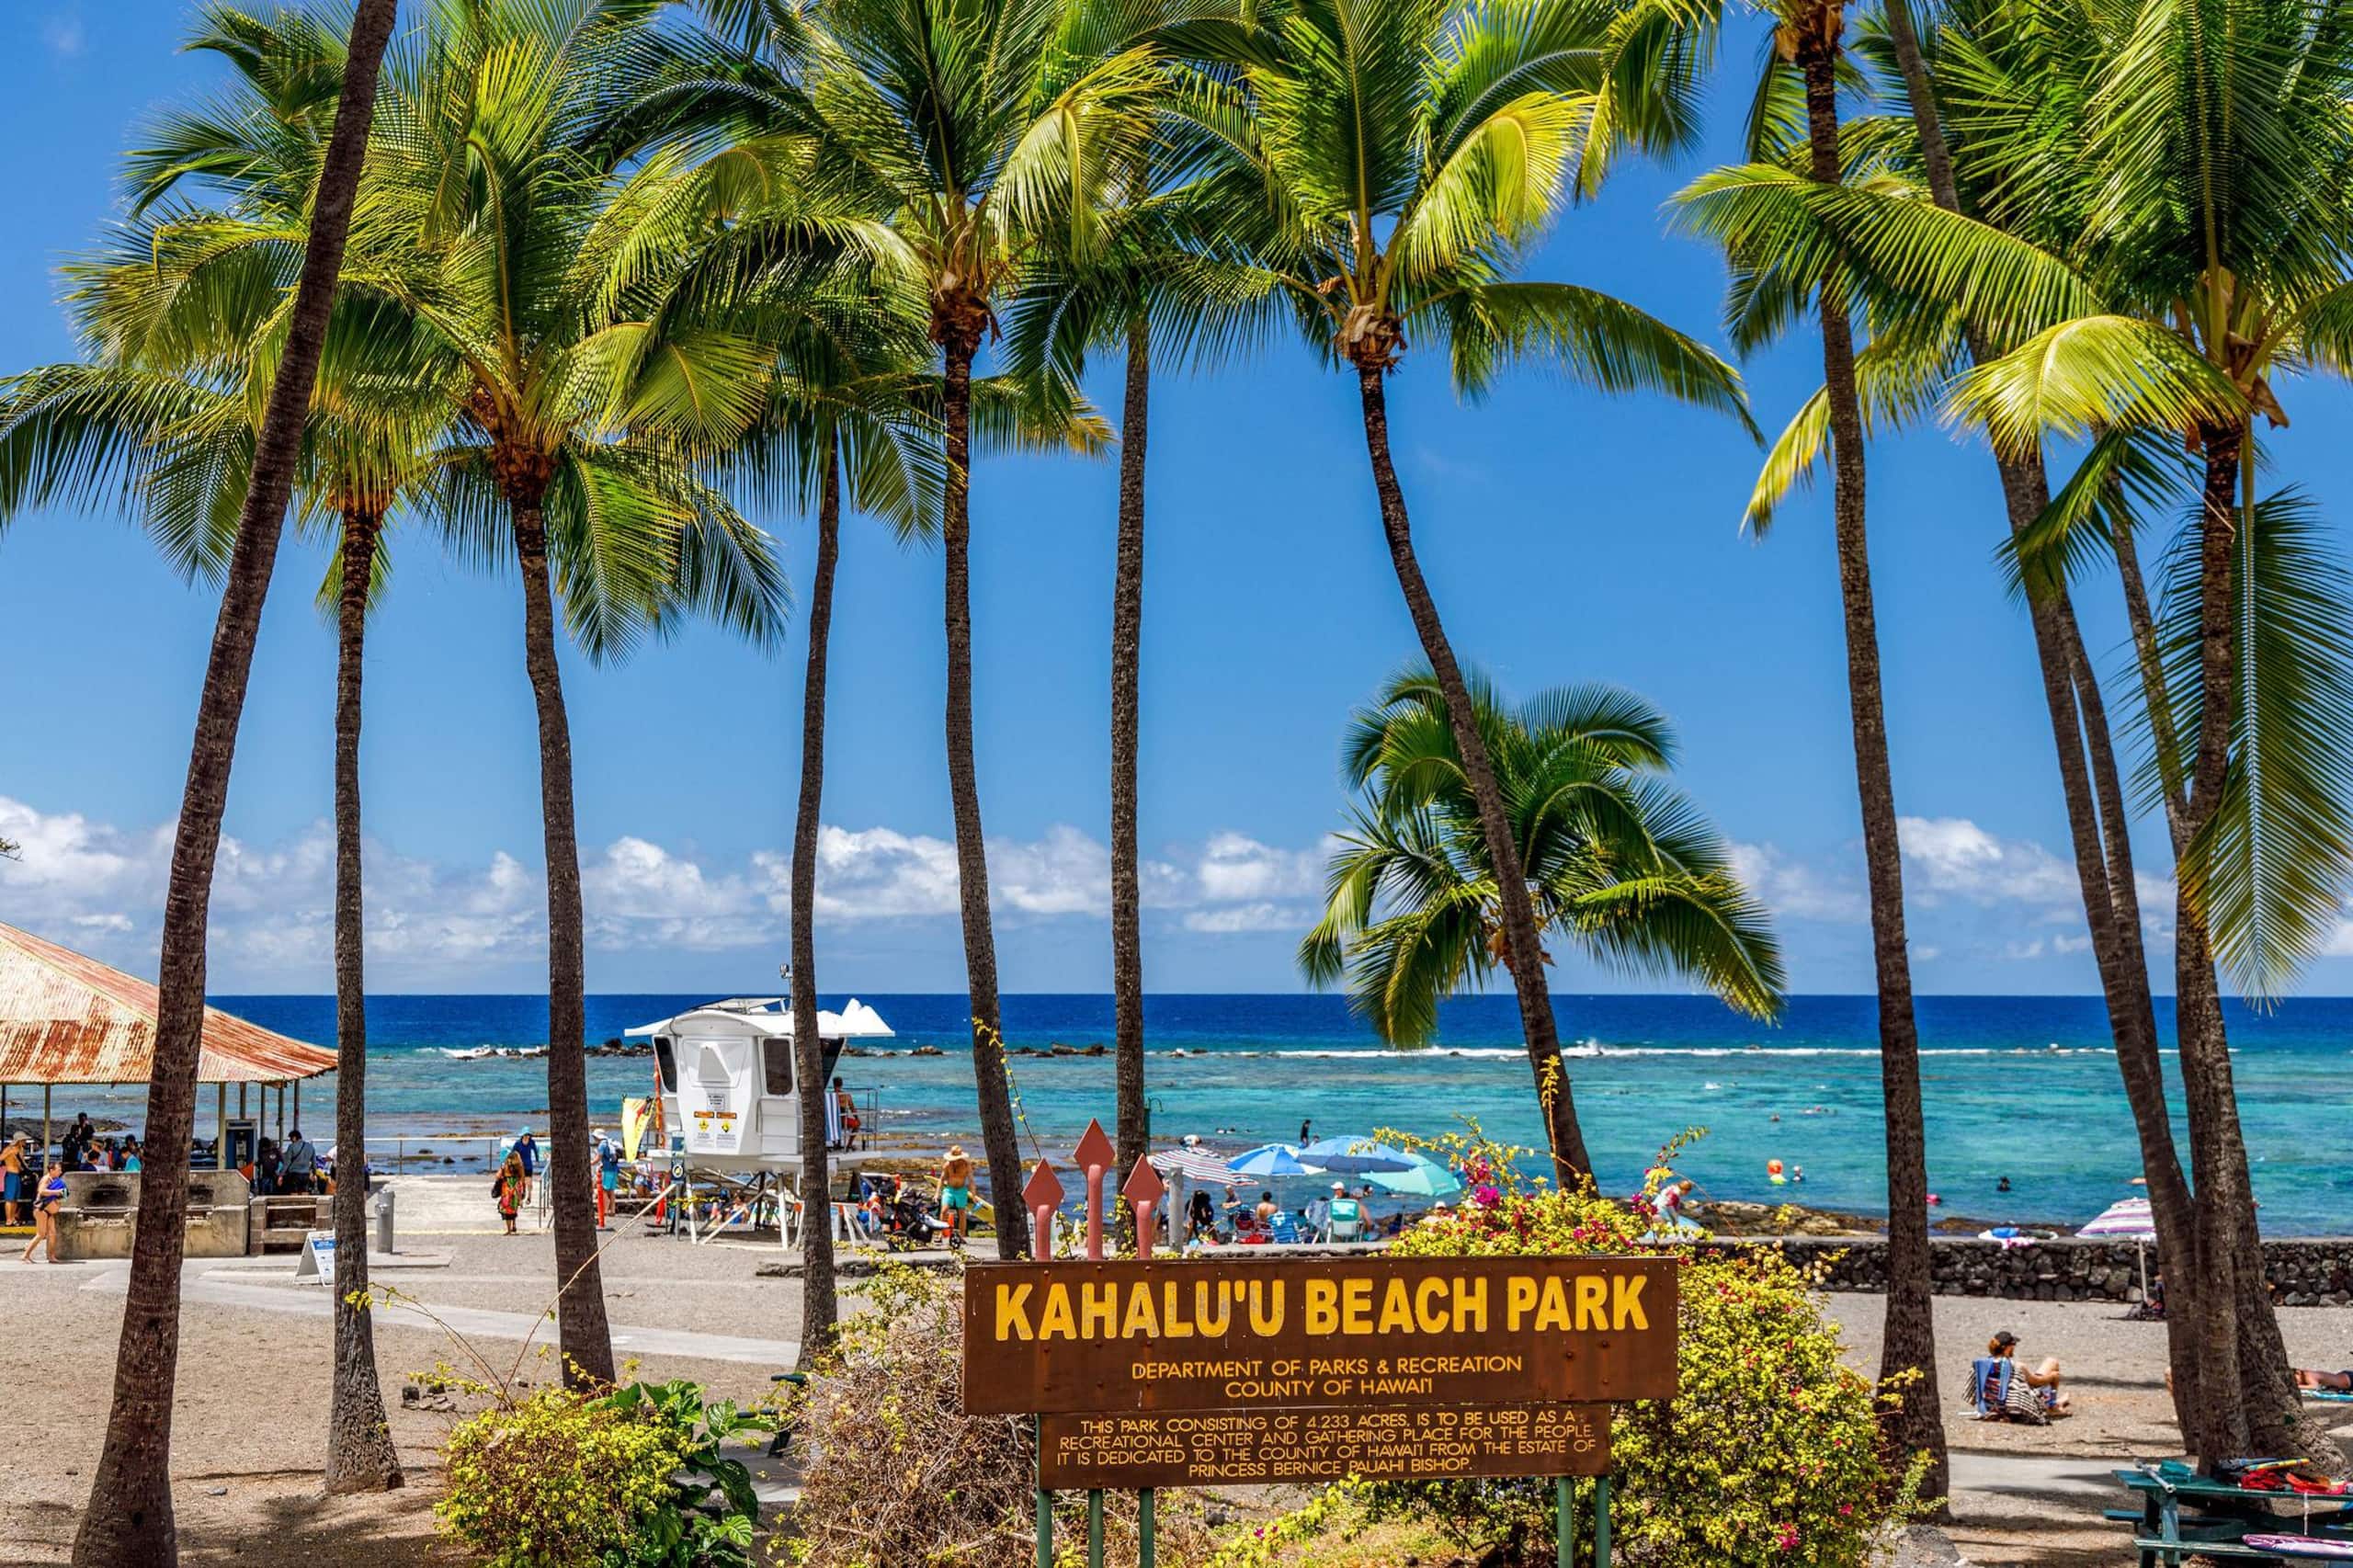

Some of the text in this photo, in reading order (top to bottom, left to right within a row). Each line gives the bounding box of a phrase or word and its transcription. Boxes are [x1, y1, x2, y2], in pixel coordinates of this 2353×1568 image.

[995, 1275, 1649, 1341] KAHALU'U BEACH PARK
[1131, 1355, 1523, 1380] DEPARTMENT OF PARKS & RECREATION
[1224, 1380, 1312, 1398] COUNTY
[1323, 1380, 1353, 1396] OF
[1081, 1419, 1114, 1435] THIS
[1120, 1418, 1159, 1434] PARK
[1165, 1416, 1267, 1433] CONSISTING
[1274, 1415, 1299, 1429] OF
[1306, 1415, 1349, 1428] 4.233
[1417, 1413, 1430, 1426] IS
[1437, 1412, 1457, 1426] TO
[1465, 1412, 1483, 1425] BE
[1489, 1411, 1529, 1425] USED
[1536, 1410, 1557, 1423] AS
[1563, 1410, 1575, 1423] A
[1060, 1425, 1595, 1450] RECREATIONAL CENTER AND GATHERING PLACE FOR THE PEOPLE.
[1057, 1451, 1070, 1466] IT
[1077, 1450, 1090, 1465] IS
[1097, 1449, 1186, 1465] DEDICATED
[1193, 1448, 1214, 1462] TO
[1222, 1447, 1251, 1461] THE
[1258, 1445, 1329, 1460] COUNTY
[1336, 1444, 1360, 1459] OF
[1429, 1442, 1476, 1456] FROM
[1483, 1441, 1511, 1455] THE
[1518, 1439, 1566, 1454] ESTATE
[1573, 1438, 1597, 1452] OF
[1188, 1457, 1472, 1478] PRINCESS BERNICE PAUAHI BISHOP.
